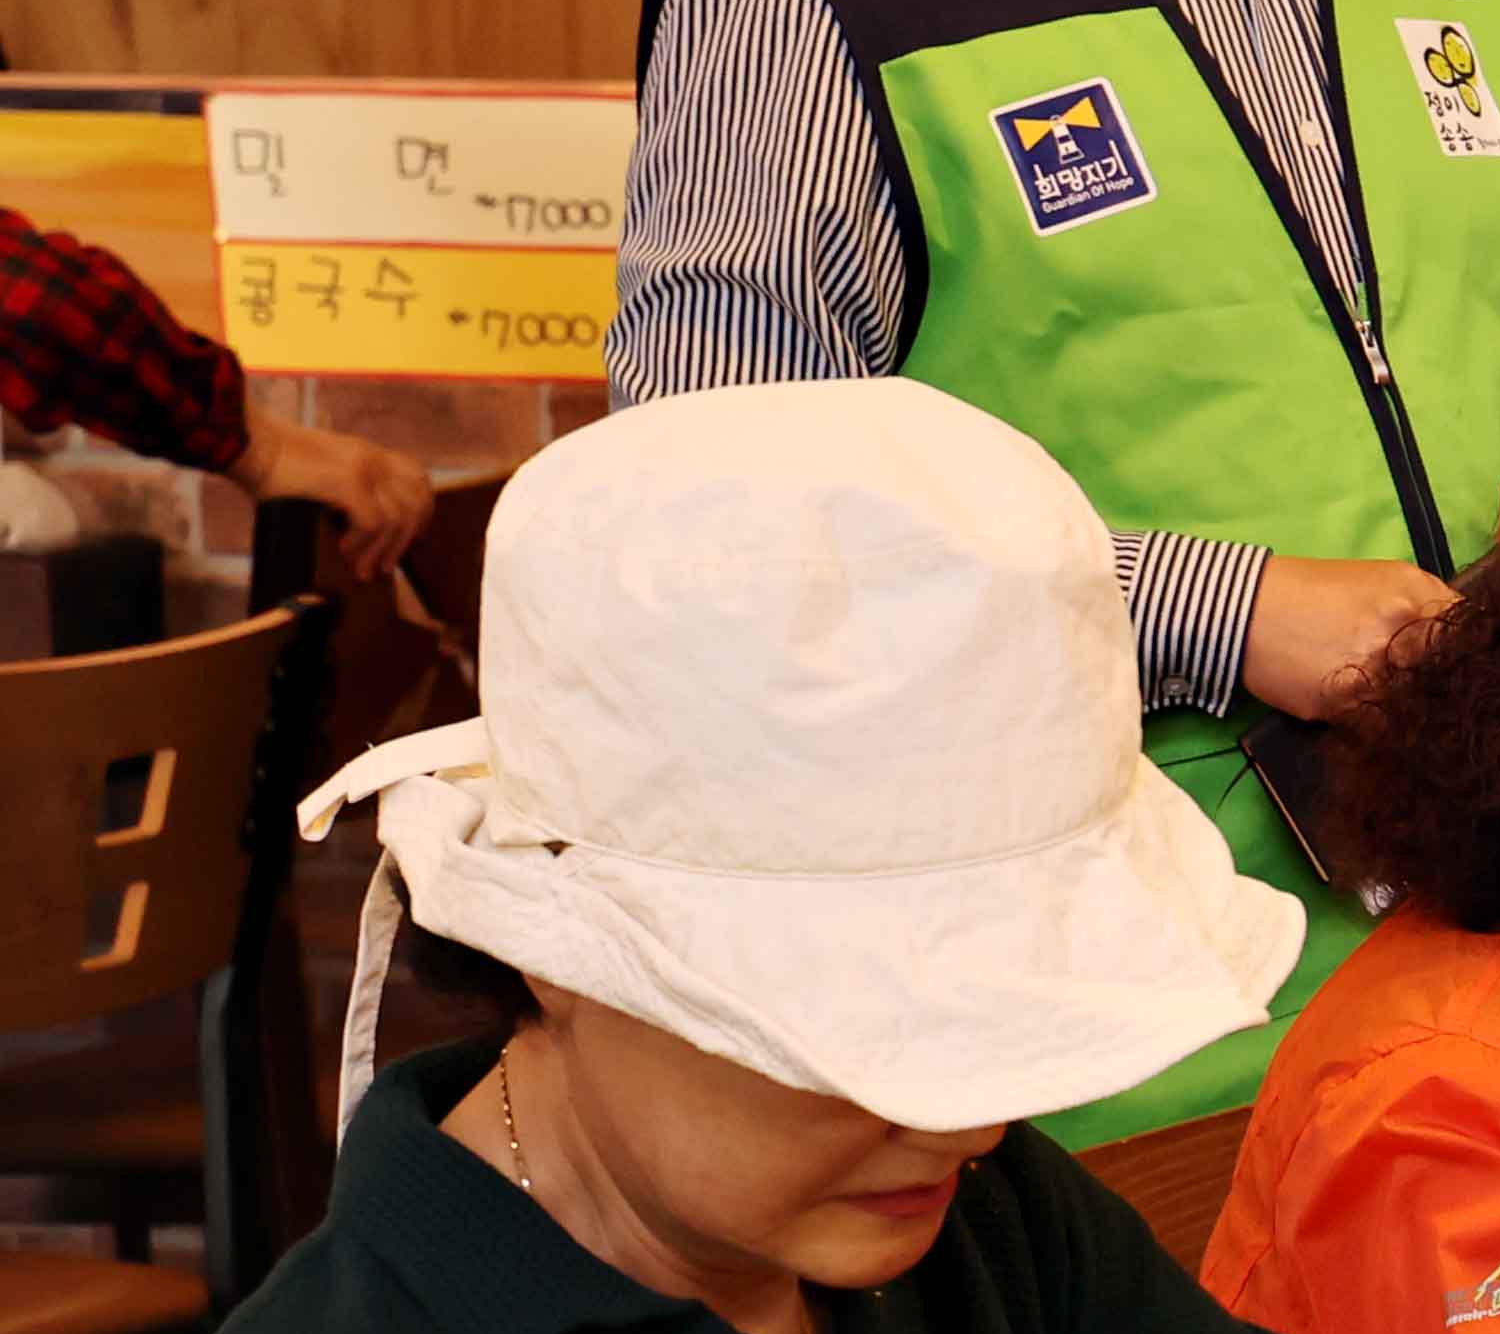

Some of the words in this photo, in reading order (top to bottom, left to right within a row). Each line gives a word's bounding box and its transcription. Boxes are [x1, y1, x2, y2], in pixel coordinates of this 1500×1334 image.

[1033, 139, 1128, 200] 희망지기
[1041, 190, 1091, 214] Guardian
[1091, 183, 1105, 197] Of
[1105, 176, 1135, 192] Hope
